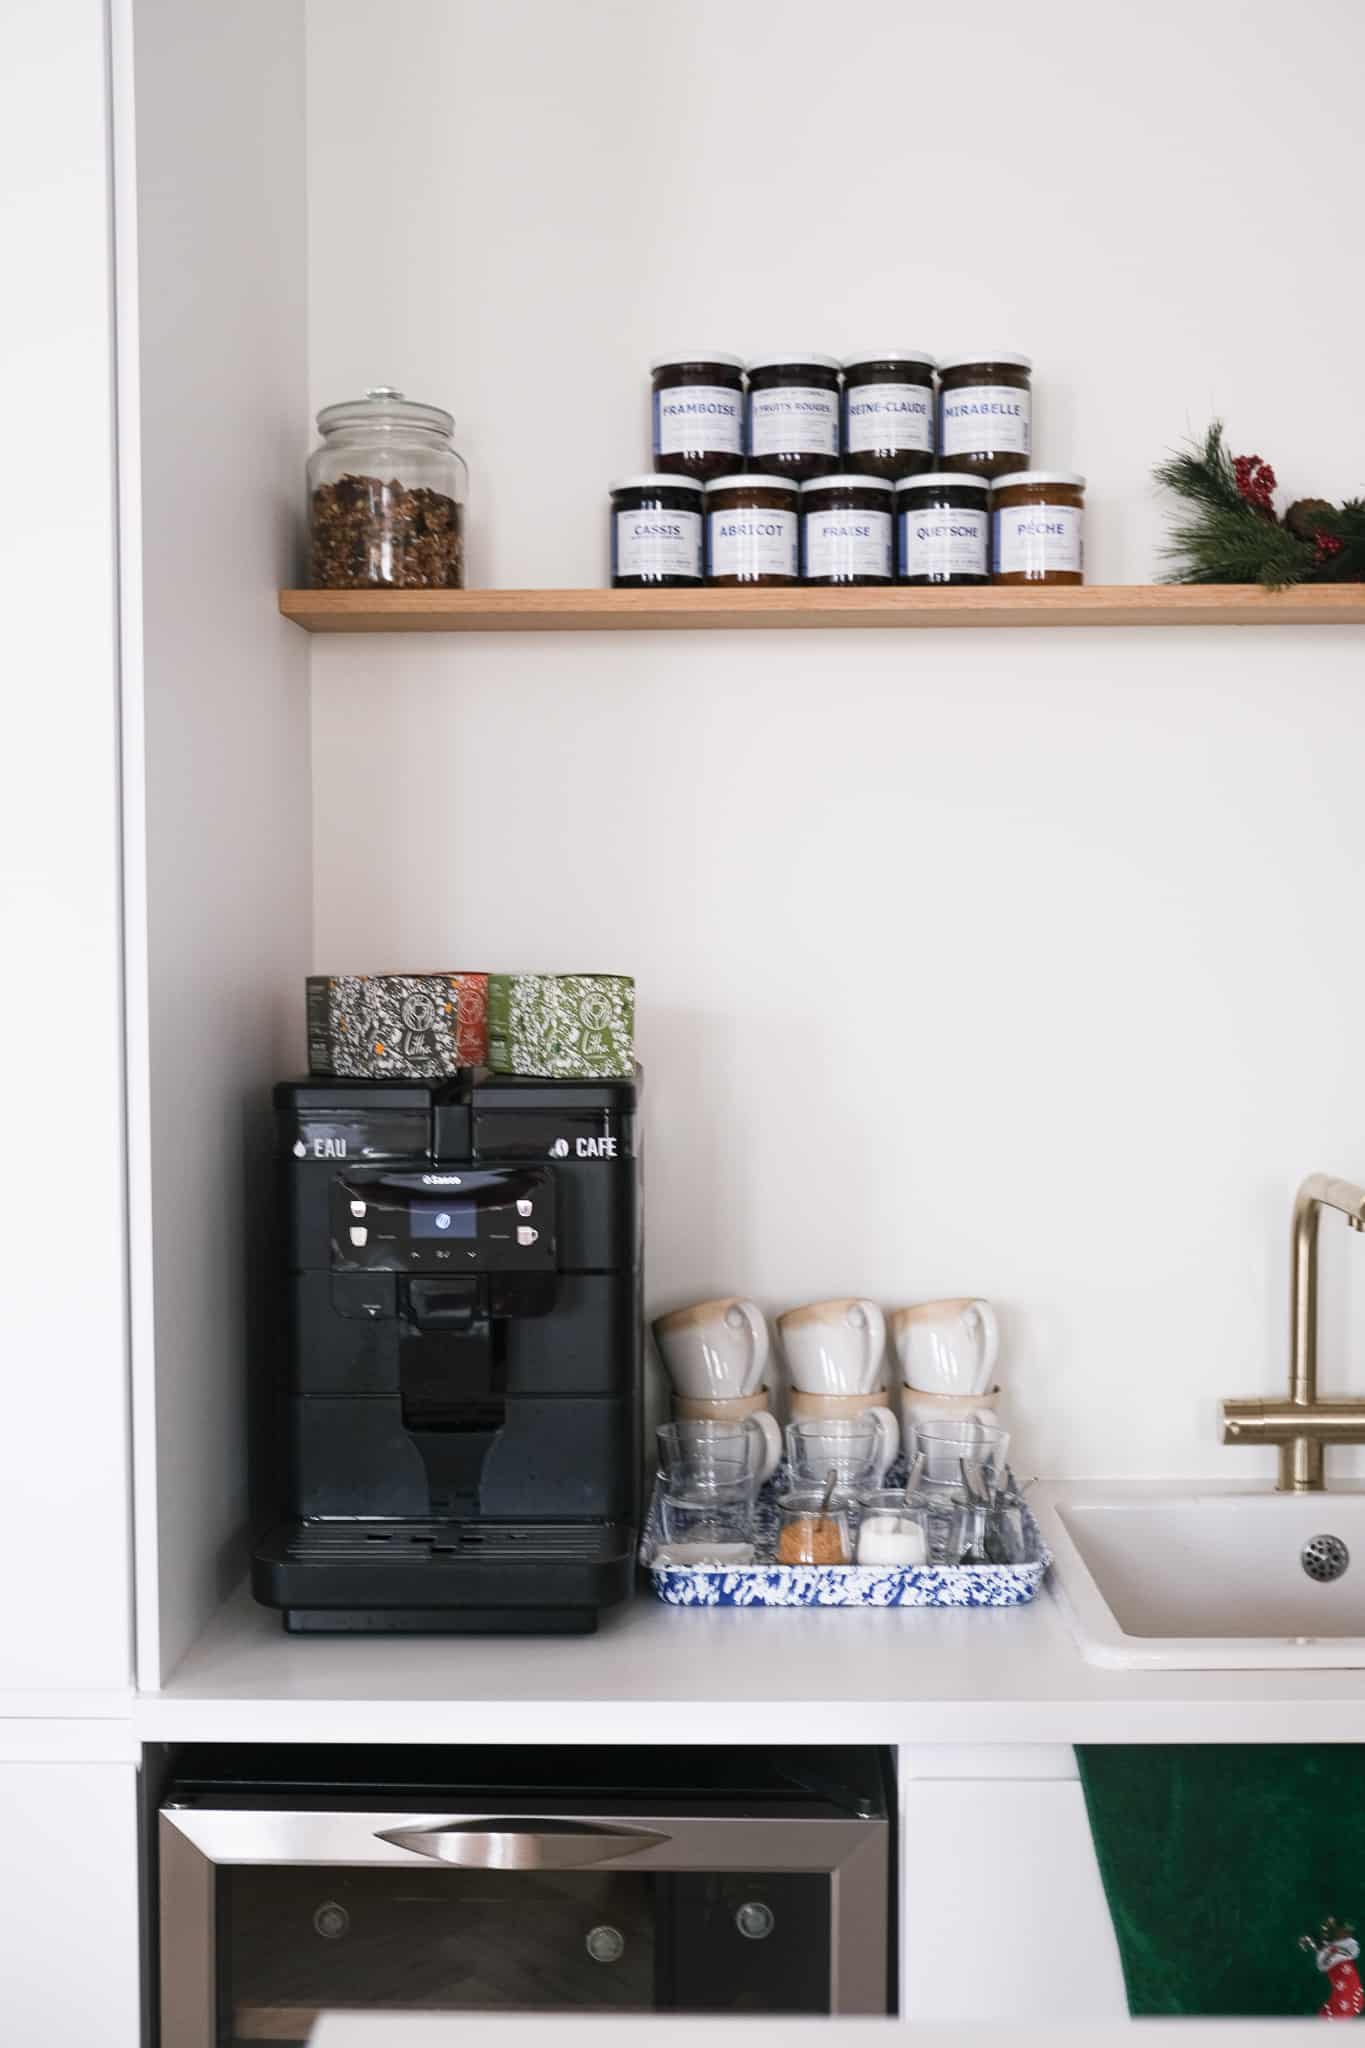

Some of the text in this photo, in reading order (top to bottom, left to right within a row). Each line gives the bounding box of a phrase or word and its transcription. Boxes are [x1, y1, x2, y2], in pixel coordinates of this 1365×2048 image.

[663, 402, 736, 417] FRAMBOISE
[850, 402, 927, 416] REINE-CLAUDE
[945, 402, 1021, 416] MIRABELLE
[633, 524, 681, 536] CASSIS
[719, 524, 784, 537] ABRICOT
[822, 526, 871, 538] FRAISE
[916, 526, 979, 541] QUETSCHE
[314, 1138, 346, 1157] EAU
[576, 1137, 617, 1157] CAFE
